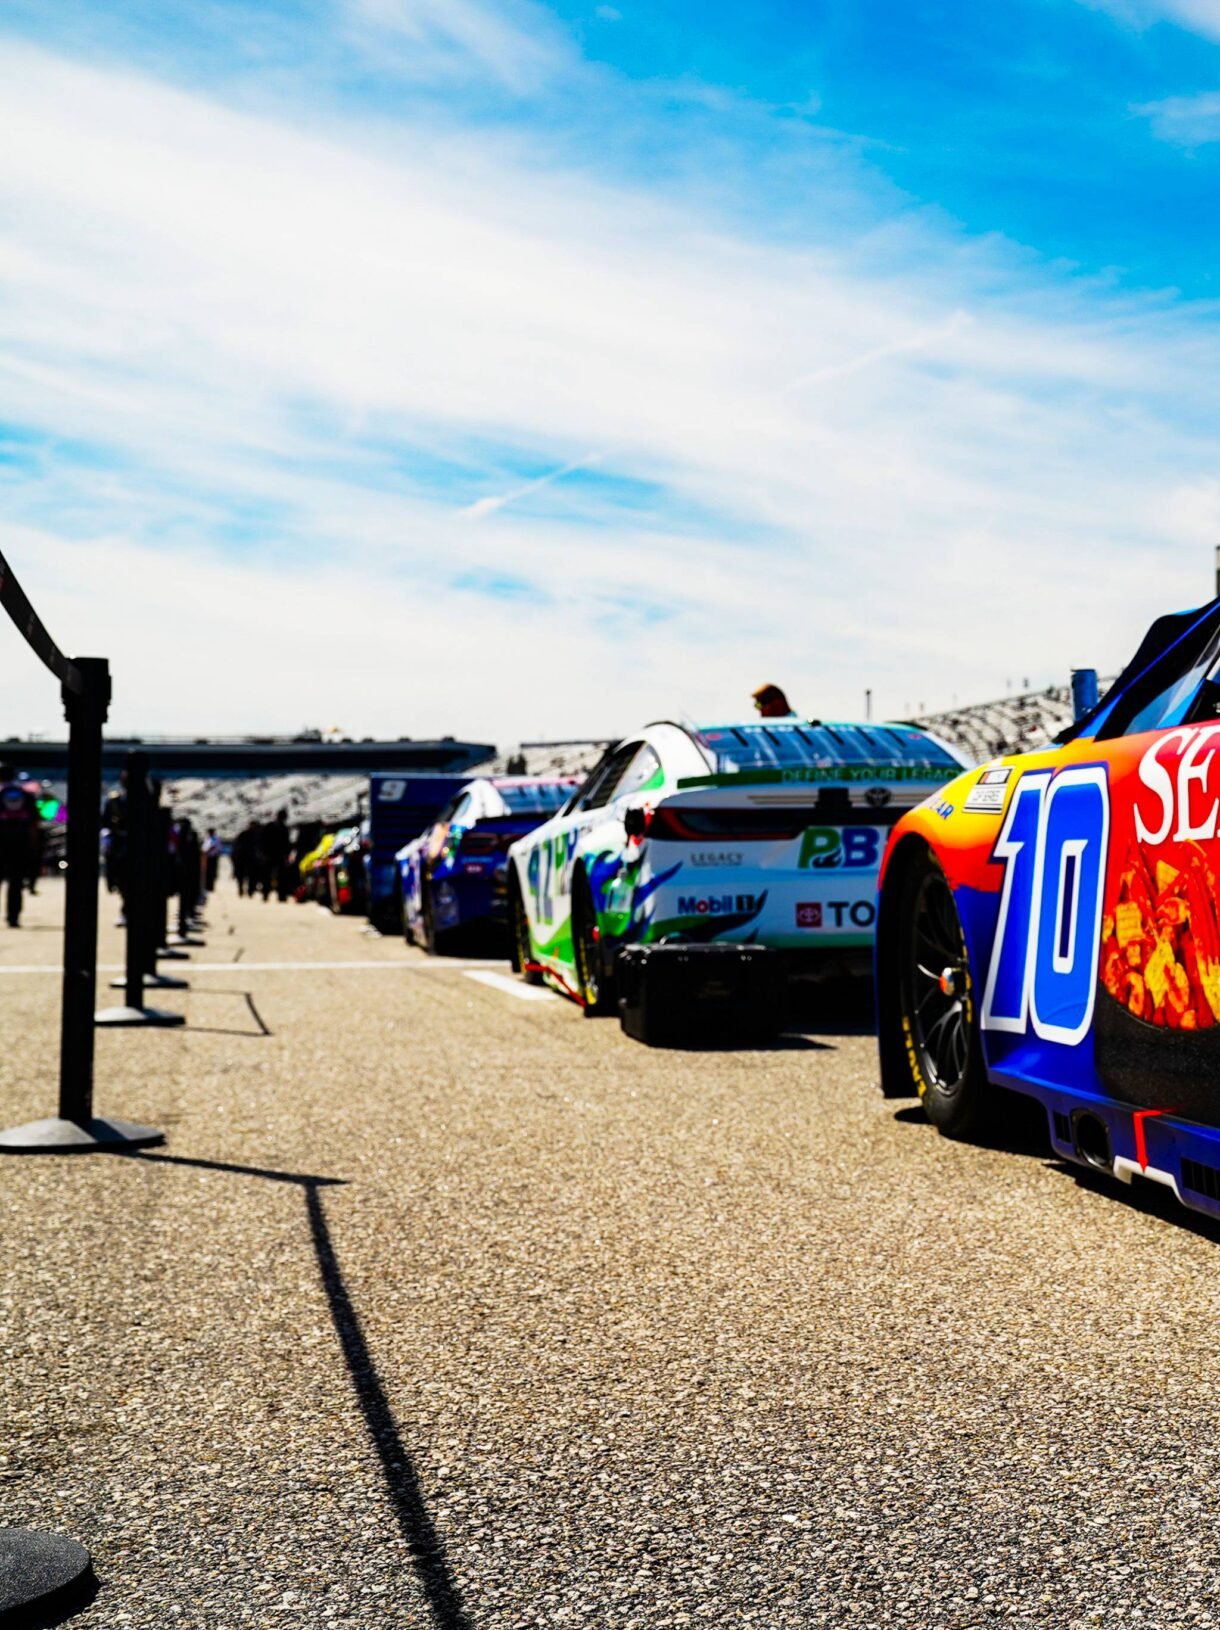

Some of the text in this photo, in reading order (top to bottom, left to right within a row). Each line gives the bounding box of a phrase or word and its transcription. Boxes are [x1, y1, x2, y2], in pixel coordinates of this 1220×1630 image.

[678, 895, 733, 914] Mobil
[827, 900, 876, 928] TO
[980, 764, 1110, 1047] 10
